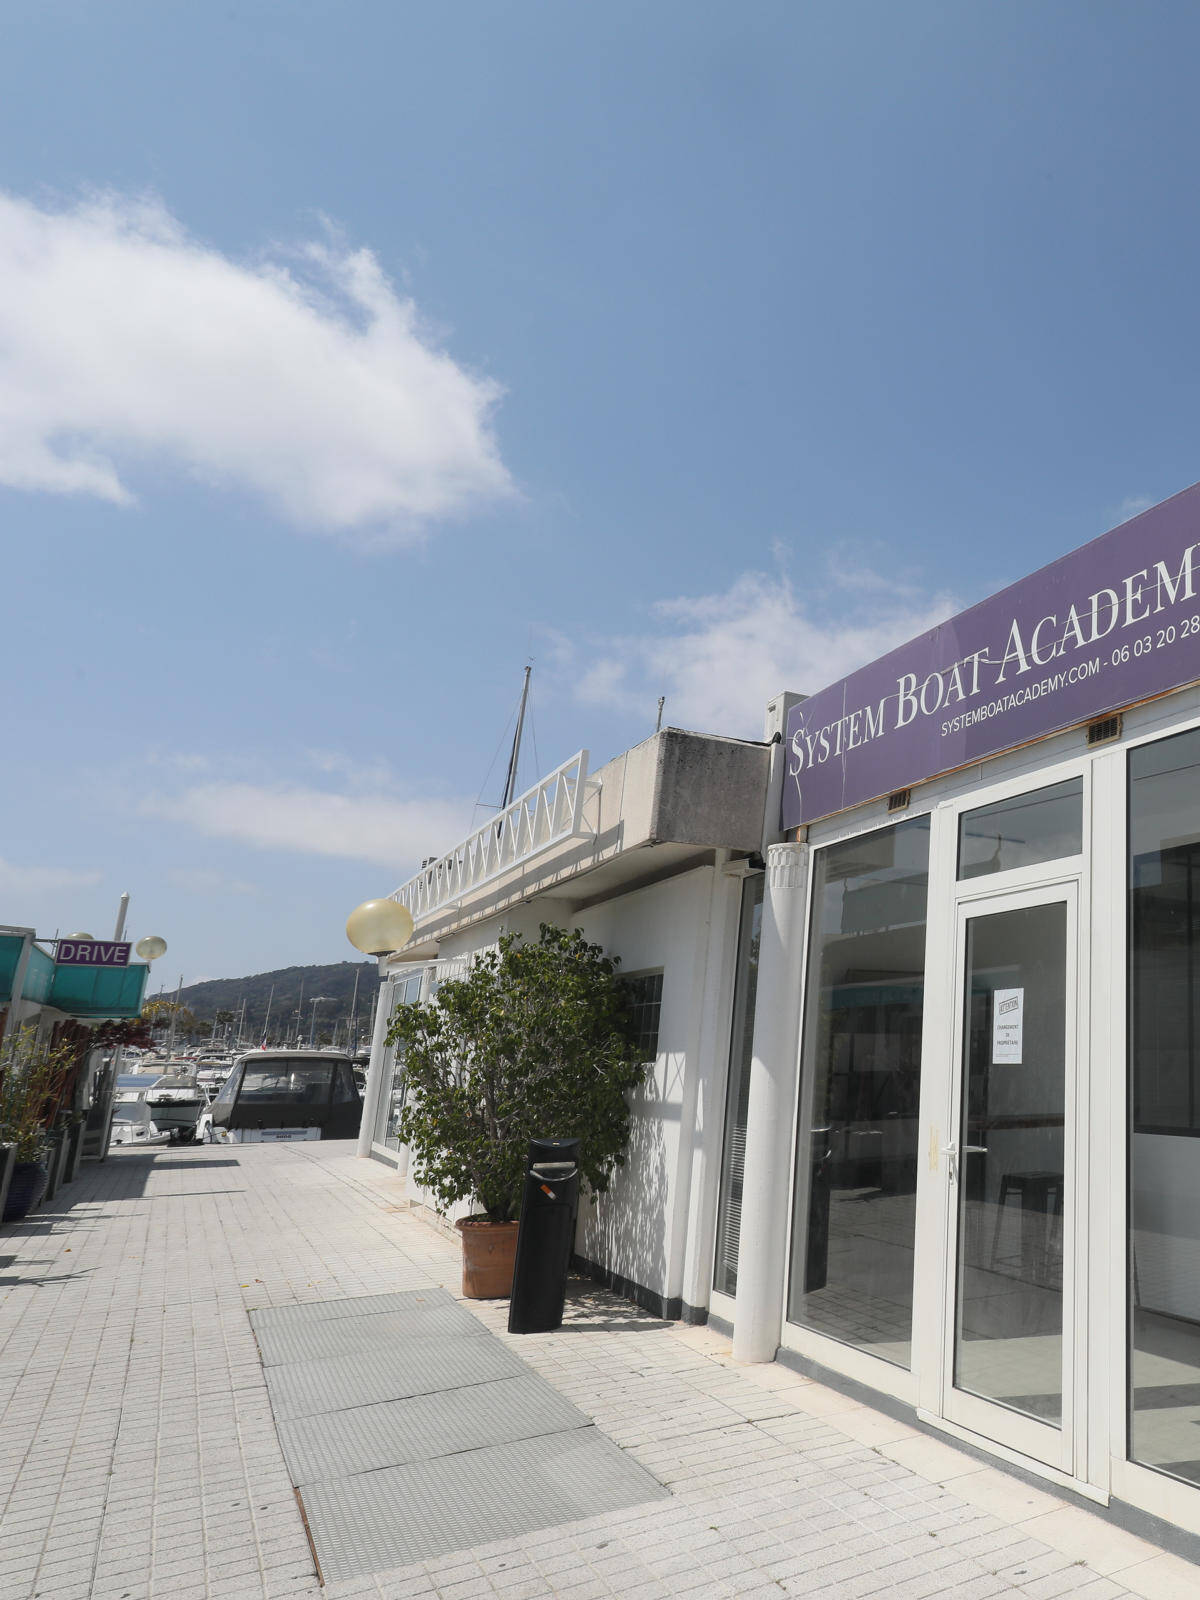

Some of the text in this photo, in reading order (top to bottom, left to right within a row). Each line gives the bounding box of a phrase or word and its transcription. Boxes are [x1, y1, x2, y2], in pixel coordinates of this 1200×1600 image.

[788, 696, 888, 777] SYSTEM
[894, 647, 989, 729] BOAT
[941, 657, 1100, 737] SYSTEMBOATACADEMY.COM
[1111, 645, 1130, 666] 06
[1133, 636, 1152, 657] 03
[1156, 626, 1176, 648] 20
[1180, 615, 1200, 639] 28
[59, 944, 128, 963] DRIVE
